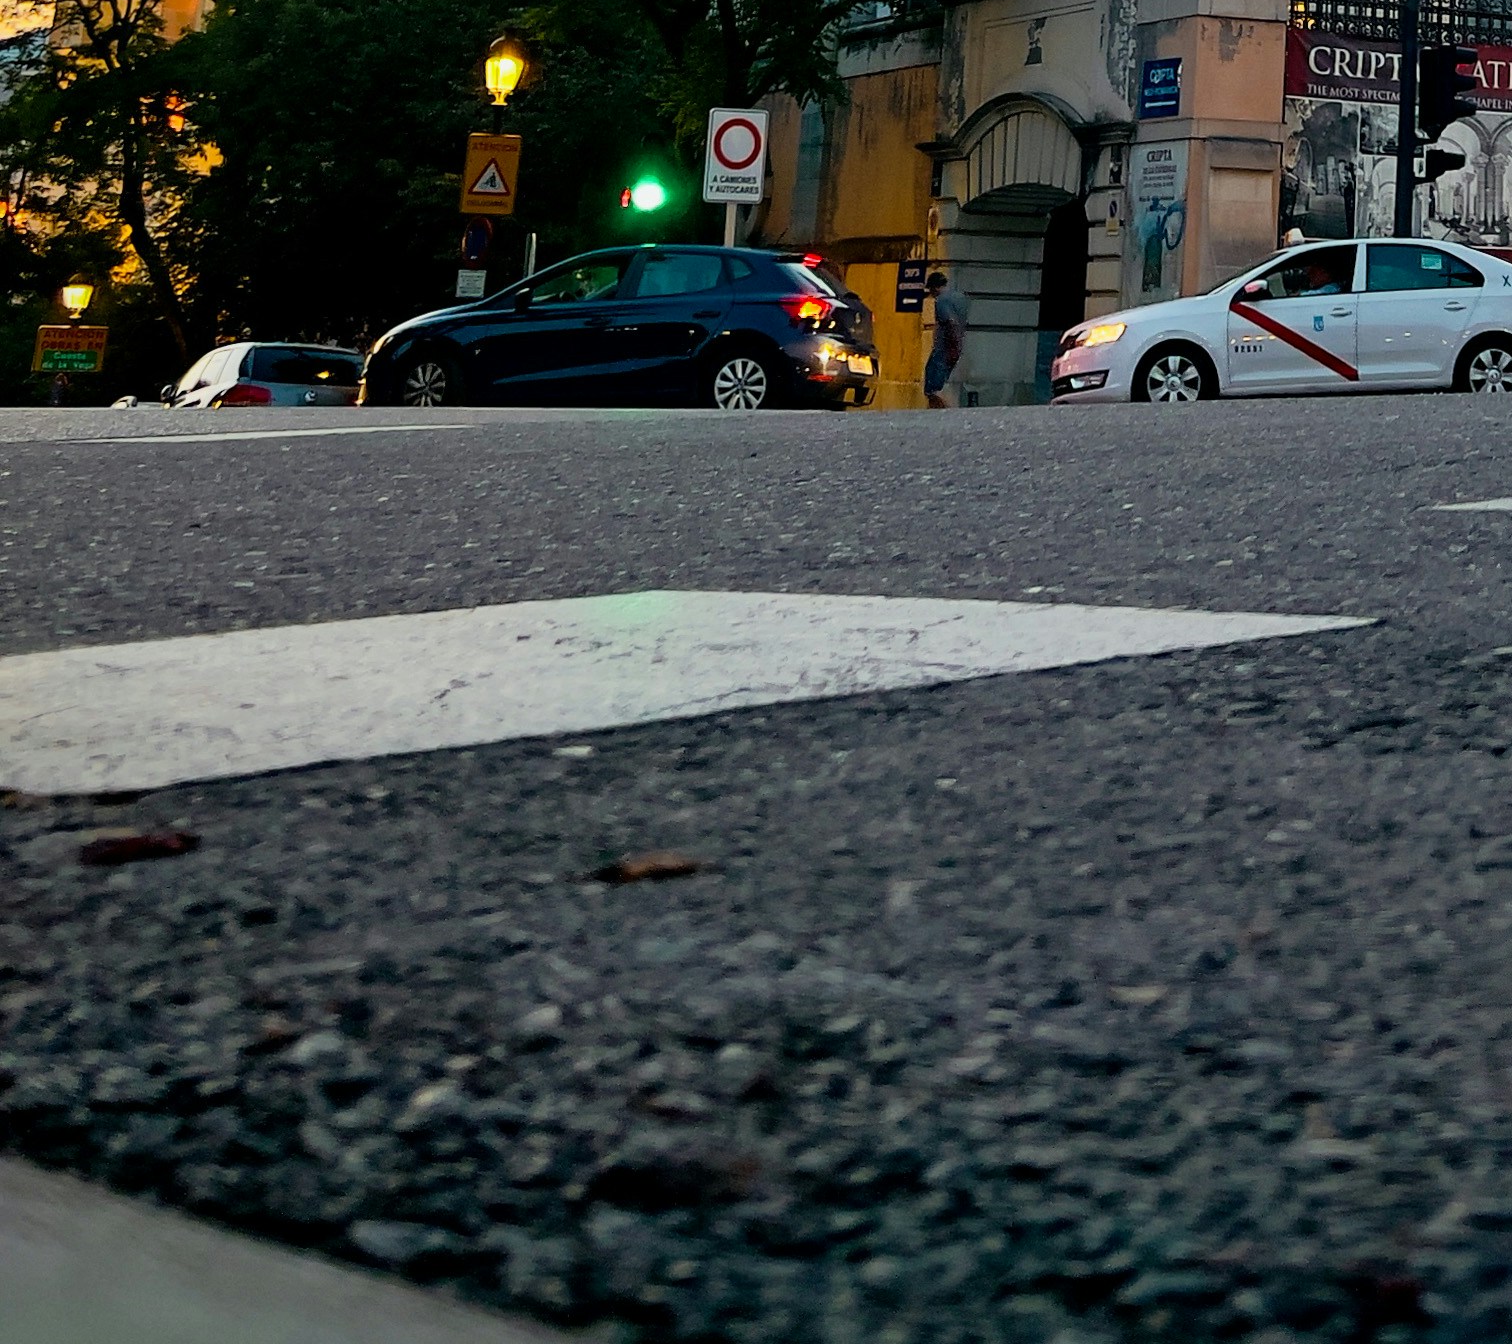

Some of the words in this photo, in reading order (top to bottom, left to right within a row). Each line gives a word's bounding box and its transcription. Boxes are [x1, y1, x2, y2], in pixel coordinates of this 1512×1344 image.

[1308, 46, 1402, 82] CRIPT
[1307, 83, 1327, 96] THE
[1329, 87, 1360, 99] MOST
[714, 185, 759, 195] AUTOCARES
[1502, 275, 1511, 287] X
